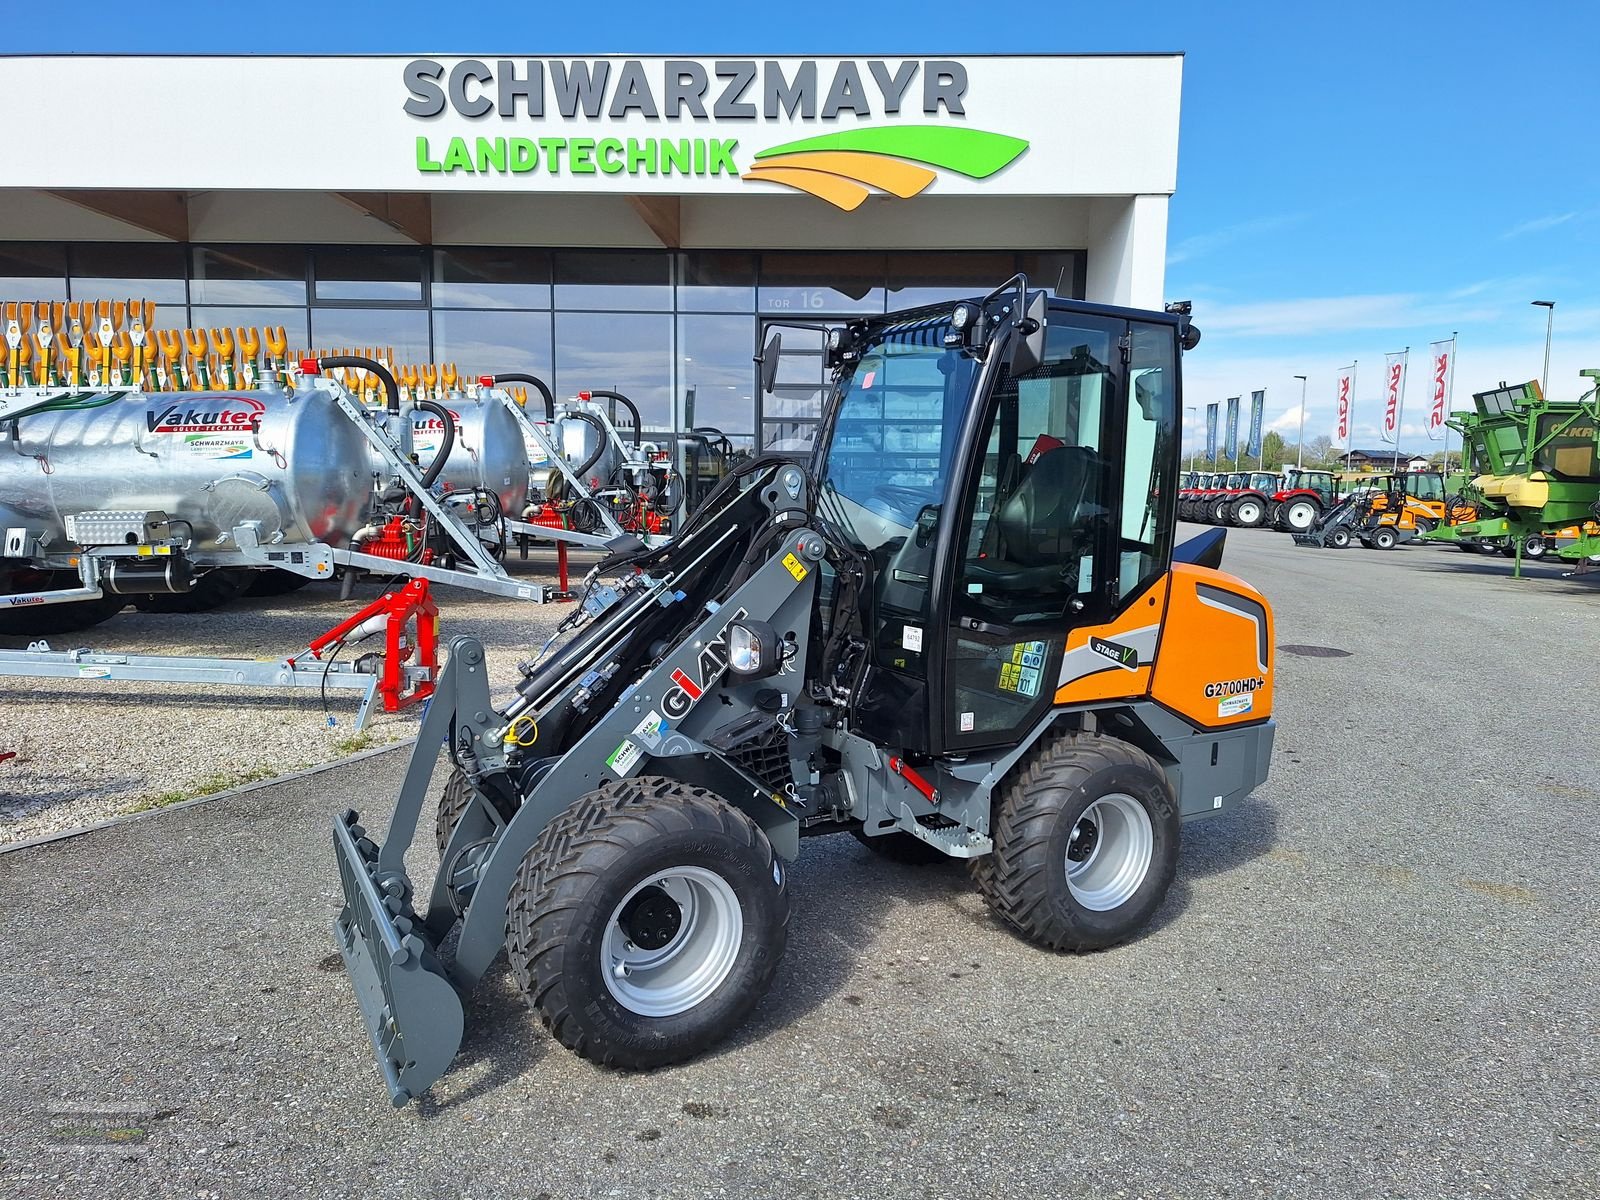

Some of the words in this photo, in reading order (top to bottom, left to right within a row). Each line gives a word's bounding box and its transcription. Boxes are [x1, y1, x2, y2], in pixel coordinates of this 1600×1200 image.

[402, 60, 969, 119] SCHWARZMAYR
[415, 136, 740, 174] LANDTECHNIK
[768, 299, 790, 308] TOR
[800, 291, 824, 309] 16
[146, 405, 265, 433] Vakutec
[1095, 643, 1120, 660] STAGE
[1122, 647, 1136, 662] V
[1204, 676, 1265, 698] G2700HD+
